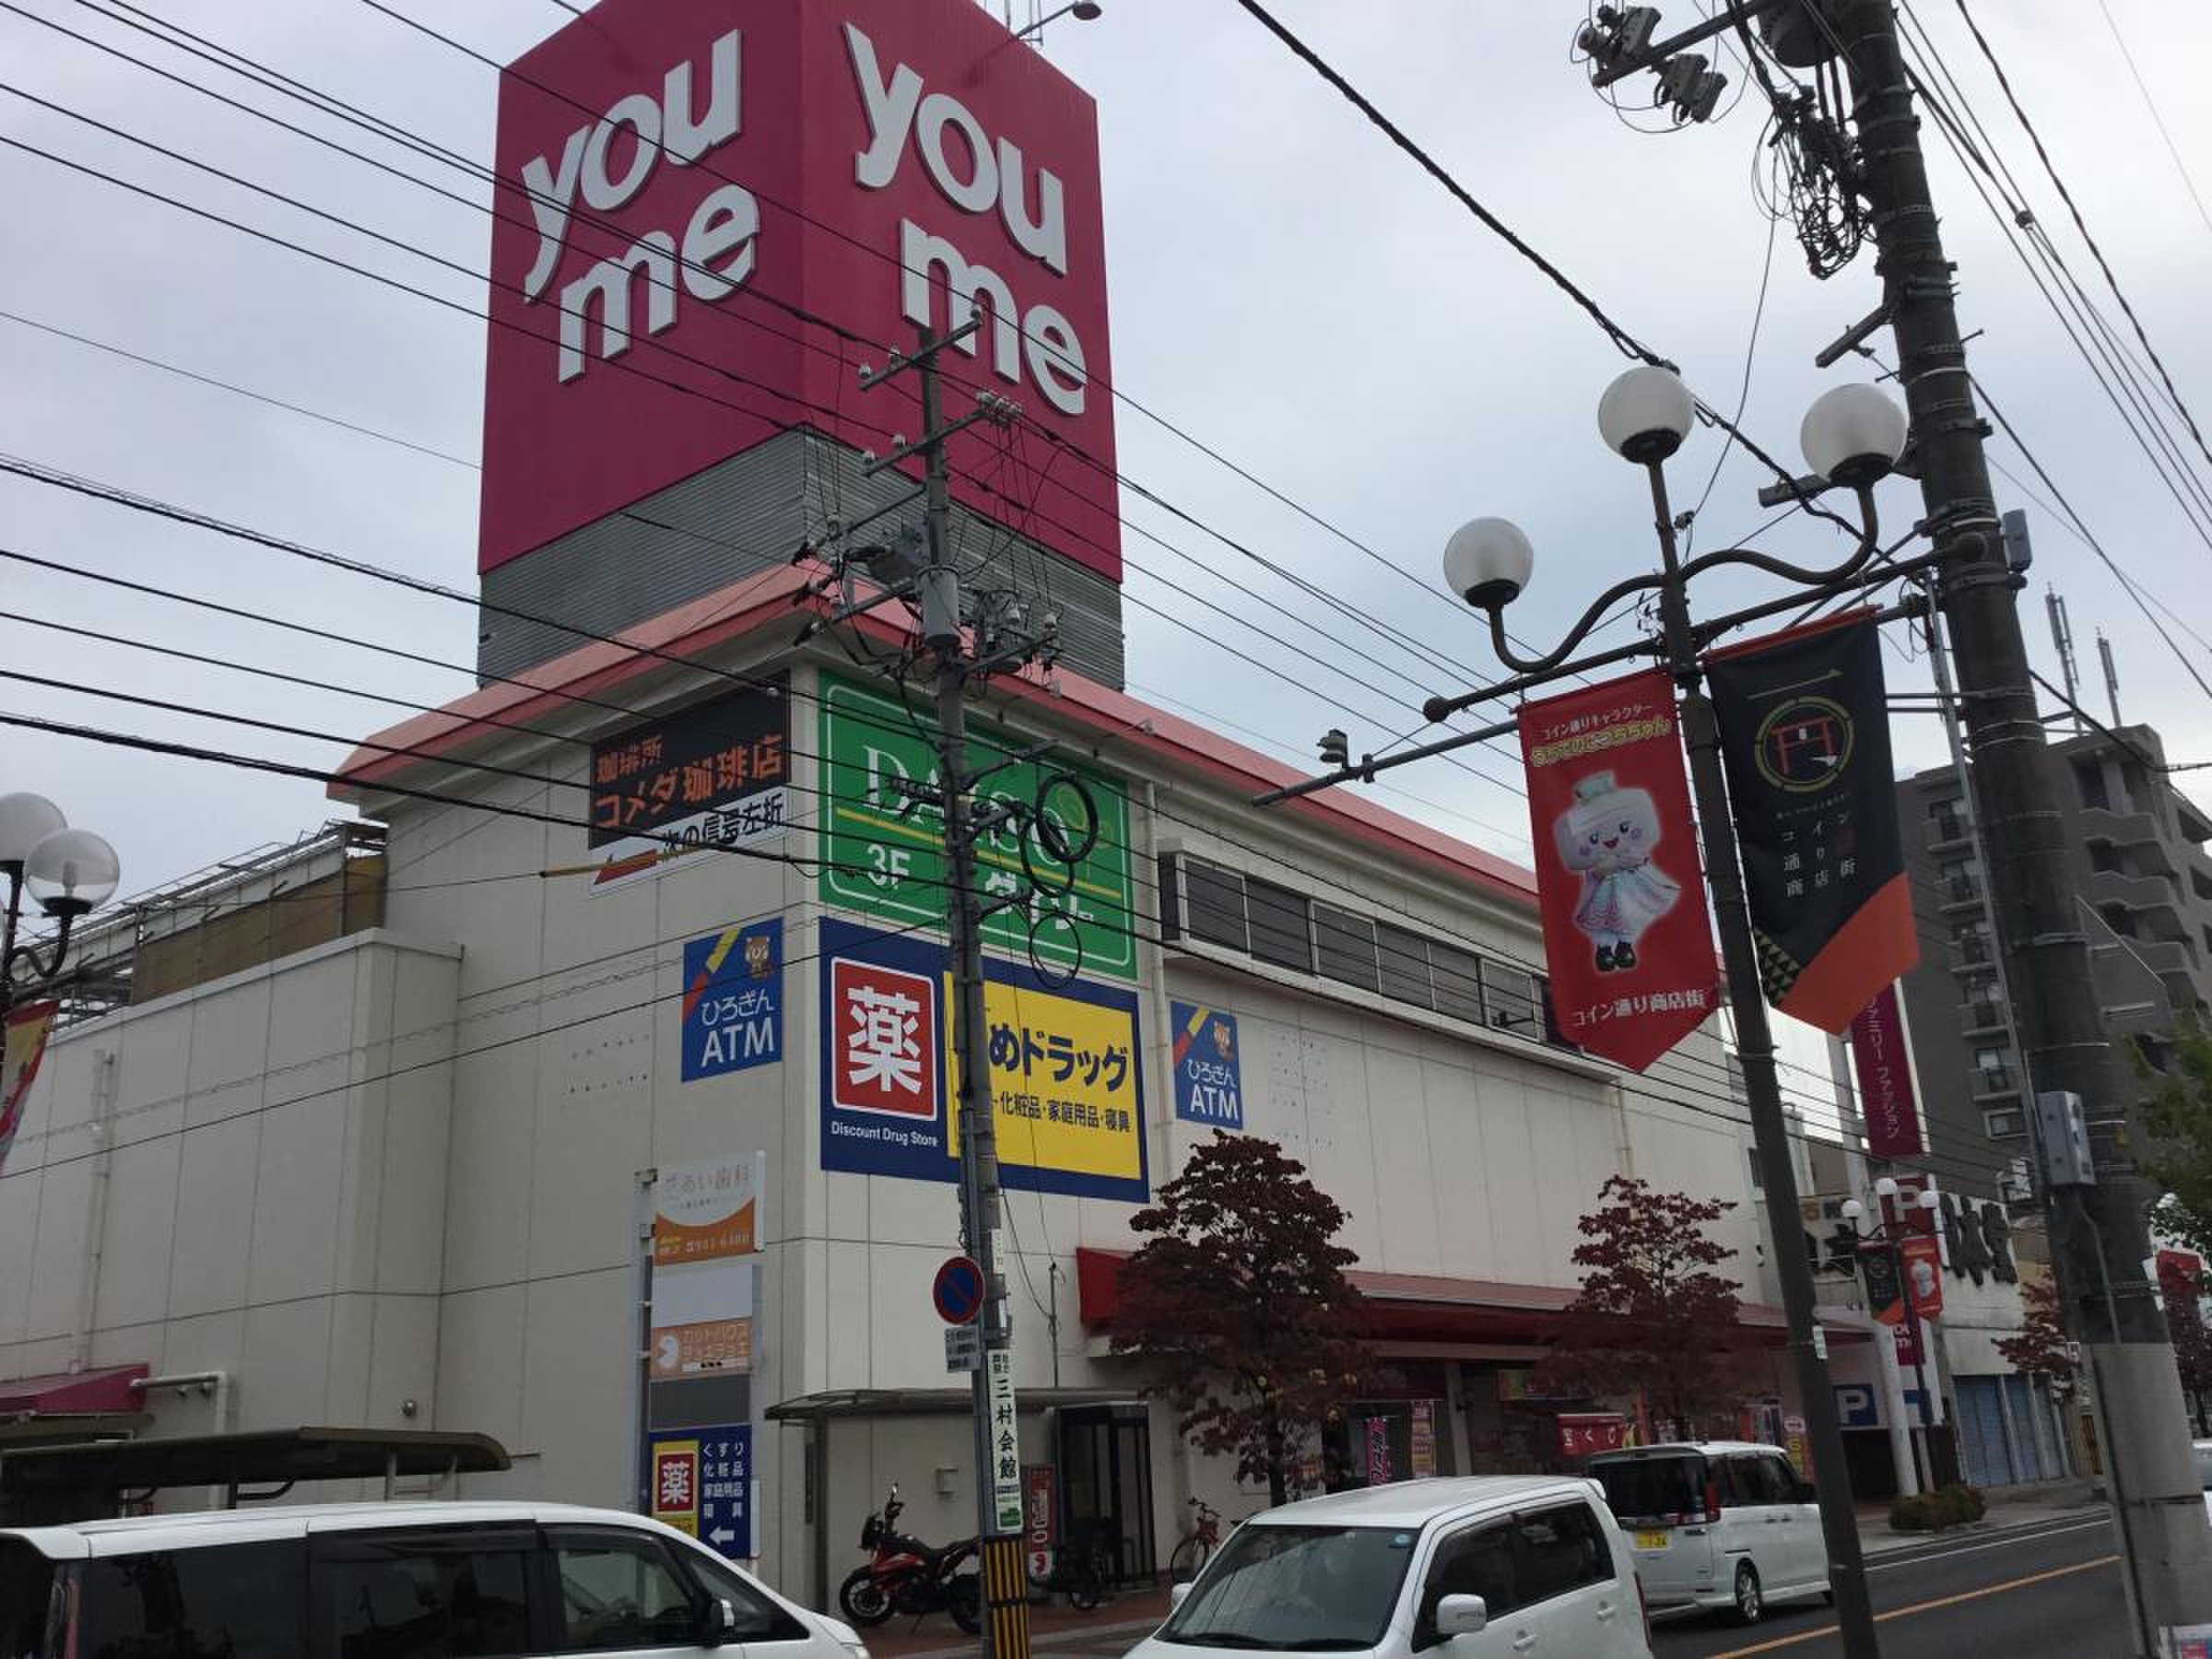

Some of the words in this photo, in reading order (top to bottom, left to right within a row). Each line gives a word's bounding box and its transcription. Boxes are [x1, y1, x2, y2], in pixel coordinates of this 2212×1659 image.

[522, 28, 743, 303] you
[842, 20, 1067, 276] you
[558, 183, 759, 384] me
[900, 218, 1088, 415] me
[594, 734, 783, 827] コメダ珈琲店
[867, 844, 911, 890] 3F
[701, 988, 774, 1026] ひろぎん
[1572, 987, 1707, 1028] コイン通り商店街
[701, 1018, 774, 1068] ATM
[847, 986, 922, 1094] 薬
[986, 1021, 1128, 1092] めドラッグ
[1187, 1058, 1238, 1090] ひろぎん
[1190, 1090, 1238, 1121] ATM
[831, 1122, 881, 1141] Discount
[882, 1128, 909, 1146] Drug
[911, 1131, 938, 1147] Store
[994, 1377, 1018, 1479] 三村会館
[1836, 1388, 1869, 1422] P
[703, 1441, 745, 1457] くすり
[703, 1461, 745, 1477] 化粧品
[662, 1461, 689, 1505] 薬
